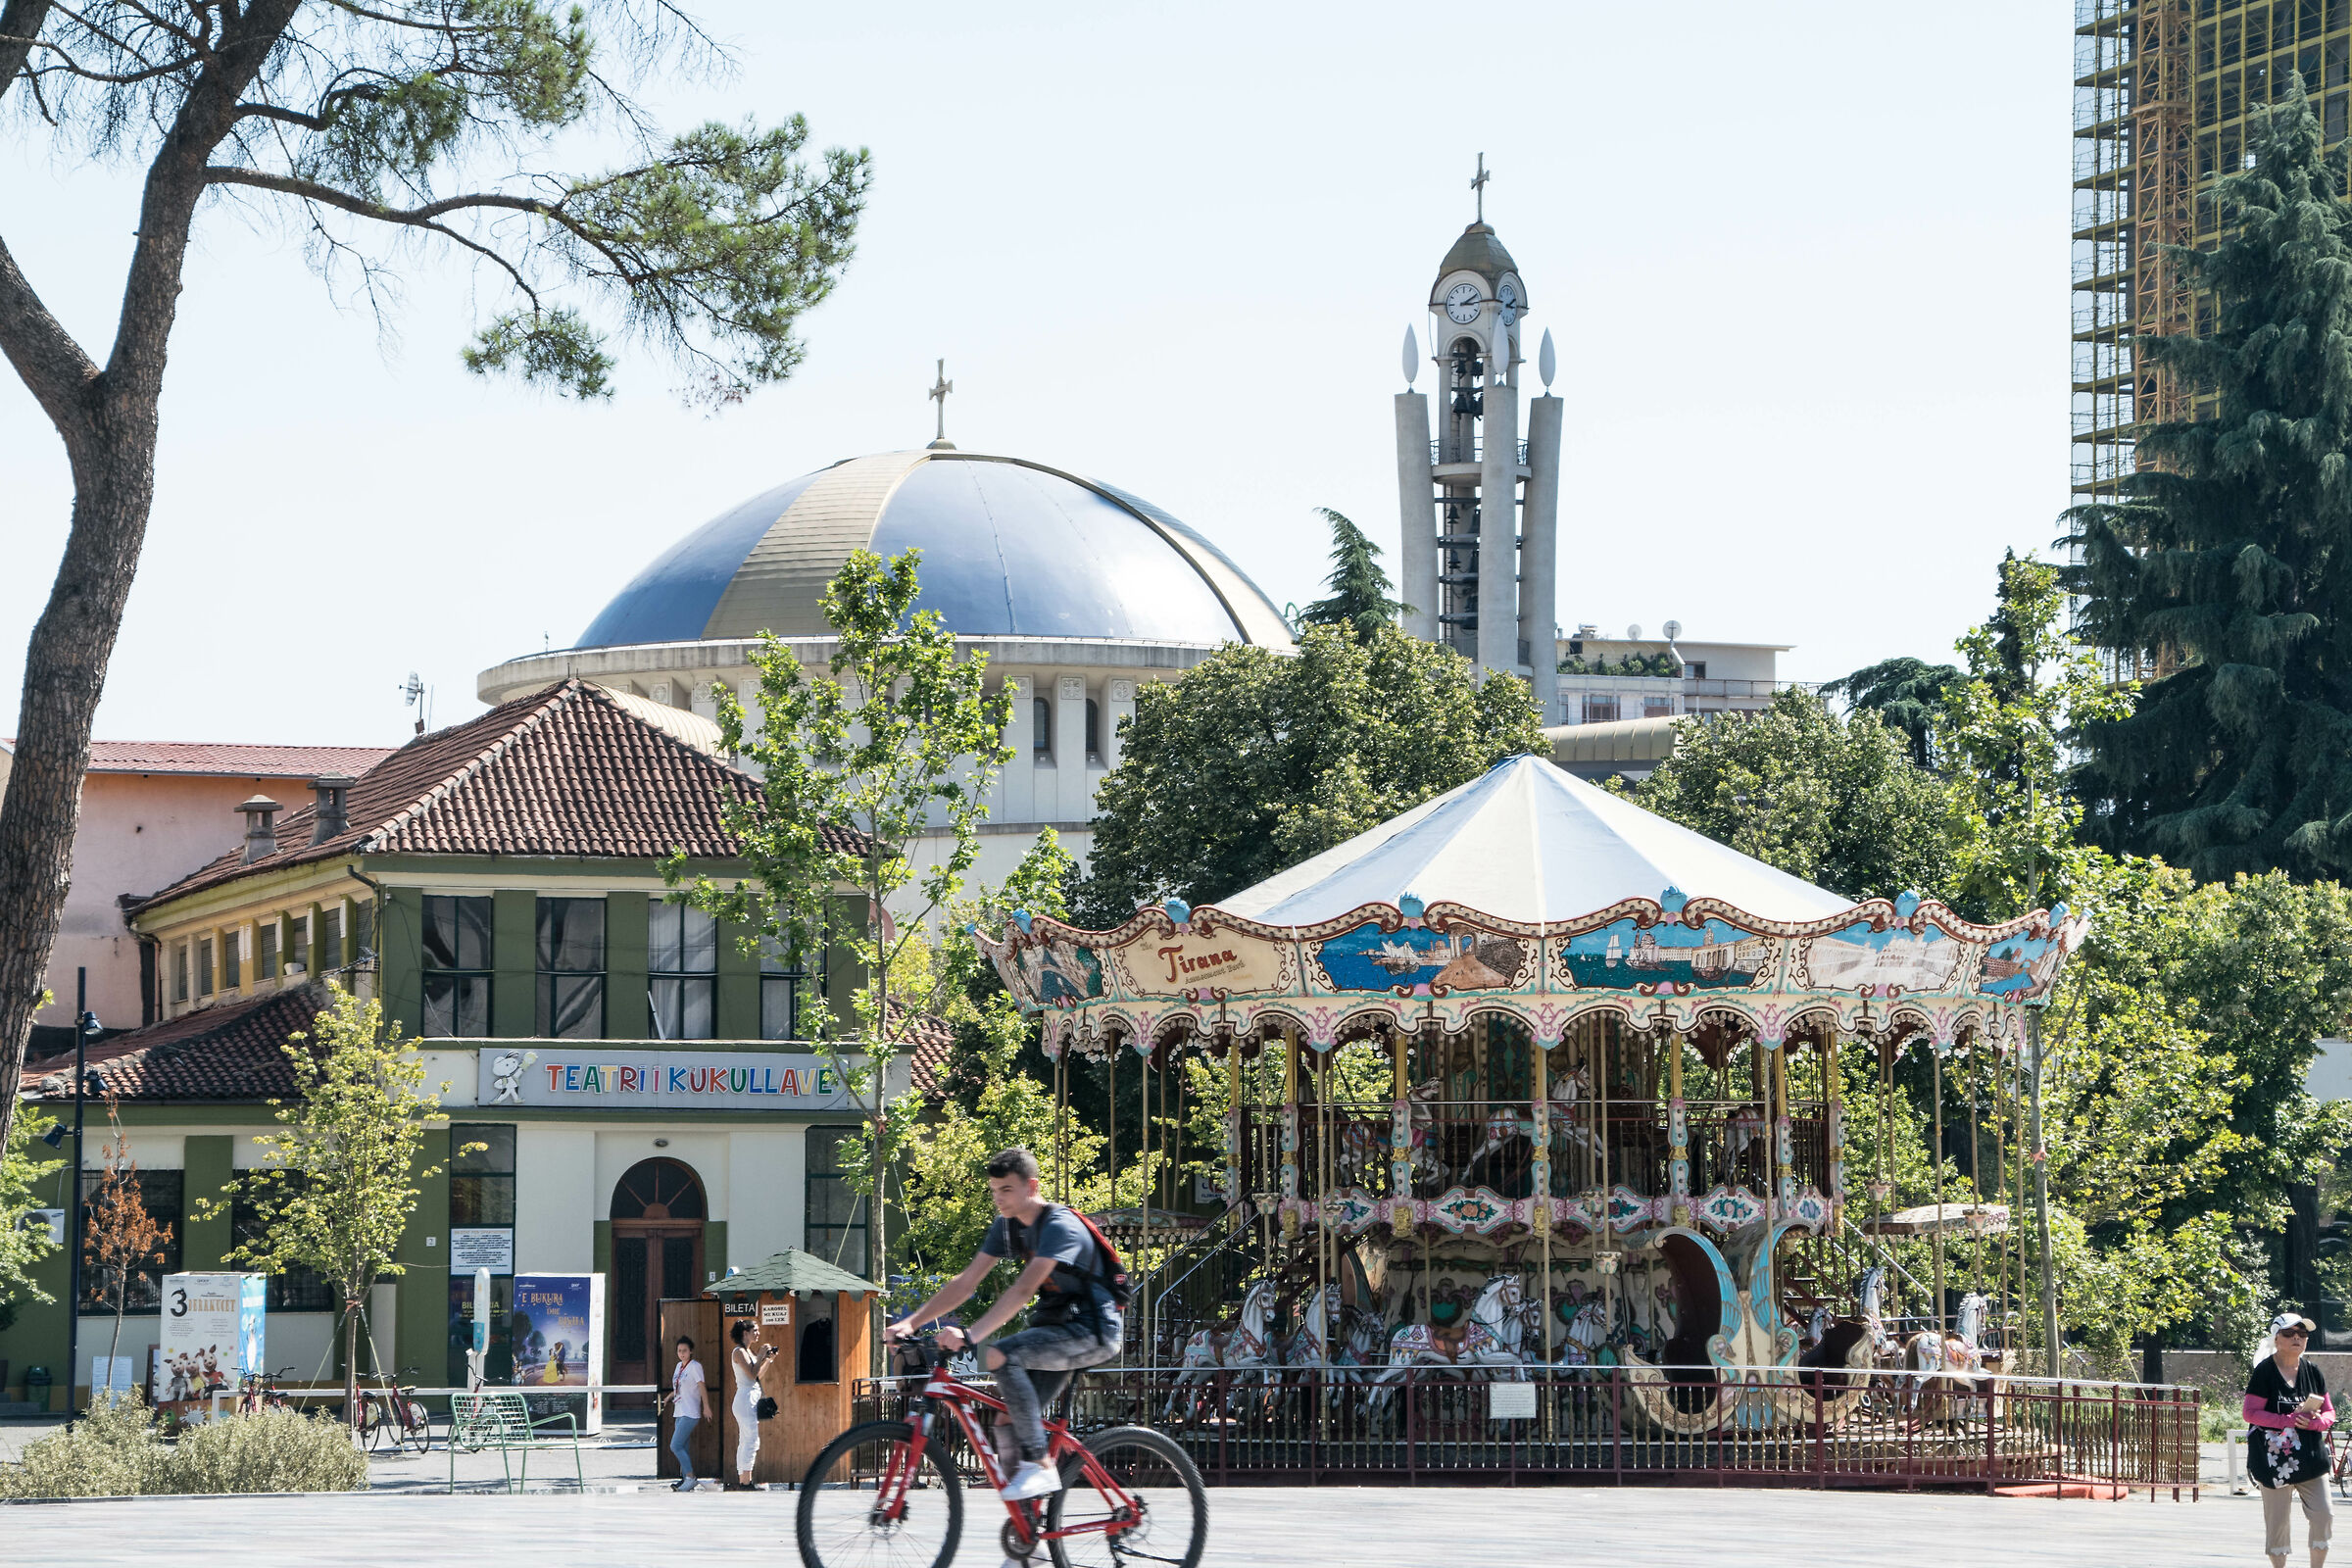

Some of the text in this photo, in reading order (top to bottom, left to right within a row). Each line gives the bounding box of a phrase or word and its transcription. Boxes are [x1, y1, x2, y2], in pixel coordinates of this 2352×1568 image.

[1157, 944, 1238, 983] Tirana
[545, 1063, 646, 1095] TEATRI
[667, 1065, 833, 1097] KUKULLAVE
[170, 1286, 188, 1317] 3
[521, 1293, 564, 1306] E BUKURA
[725, 1303, 756, 1313] BILETA
